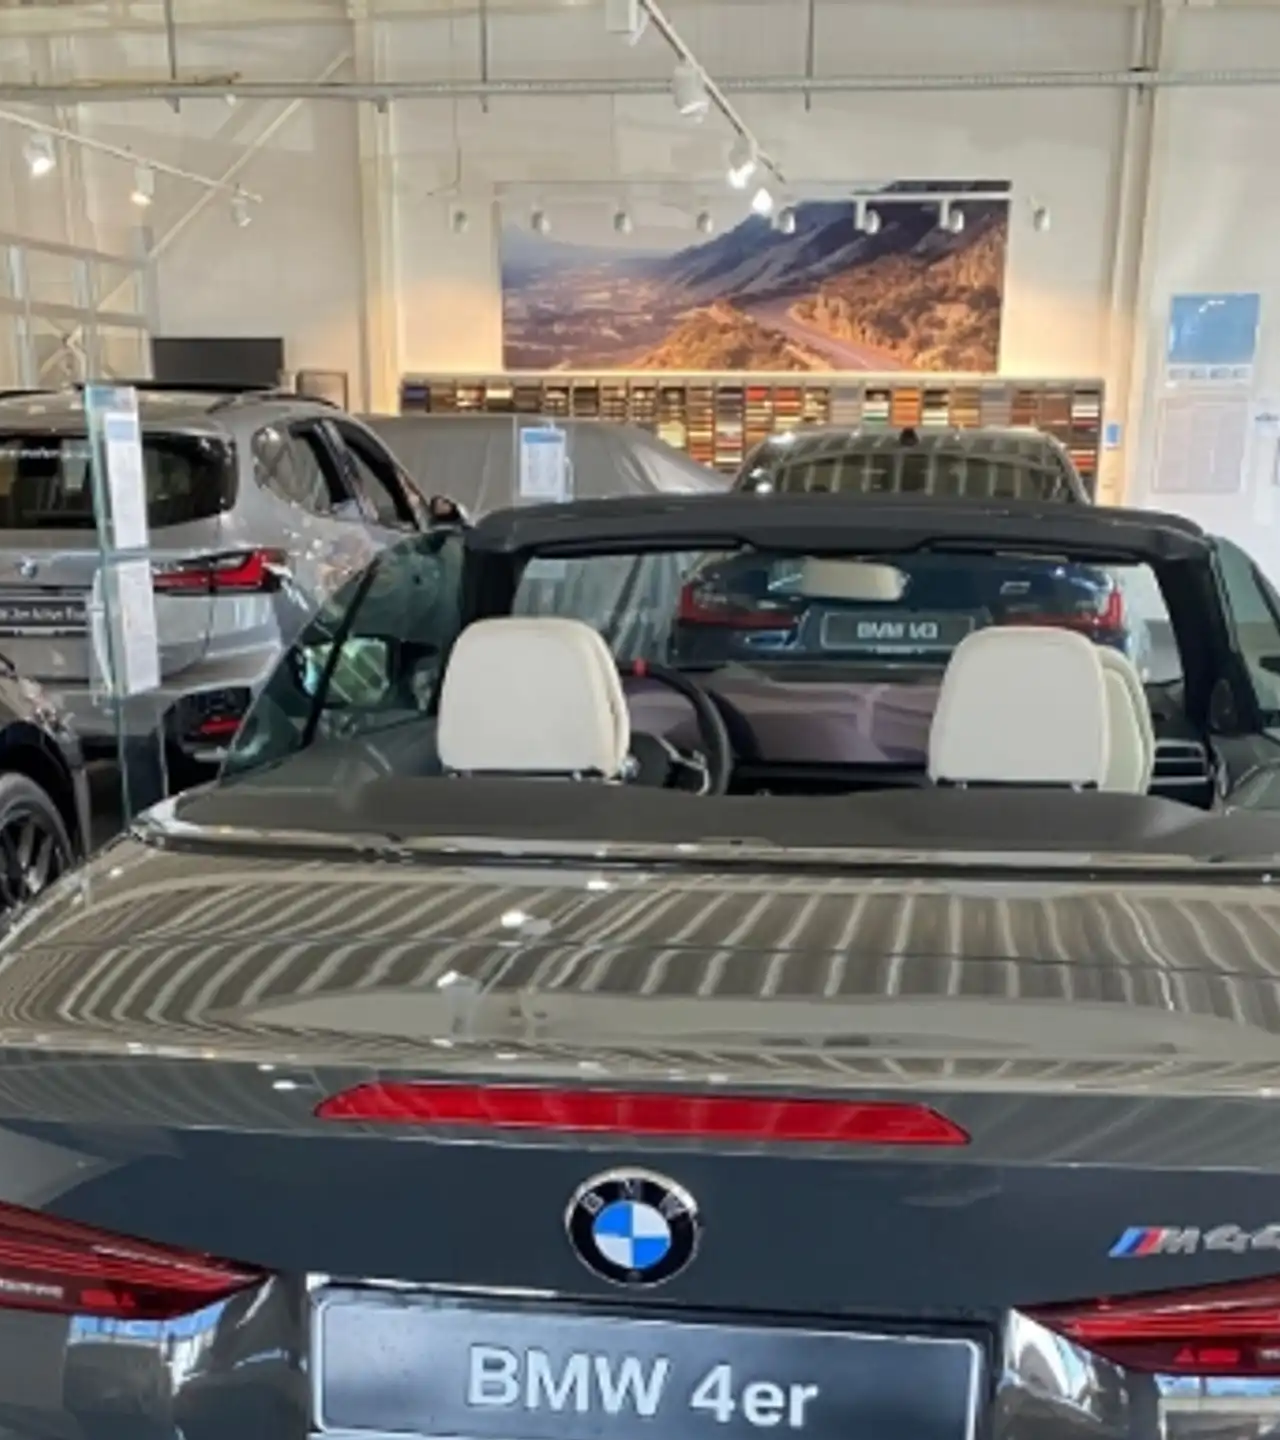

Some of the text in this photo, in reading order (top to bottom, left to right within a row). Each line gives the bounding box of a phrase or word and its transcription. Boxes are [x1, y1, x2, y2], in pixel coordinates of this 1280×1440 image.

[579, 1177, 692, 1222] BMW
[467, 1345, 819, 1429] BMW 4er
